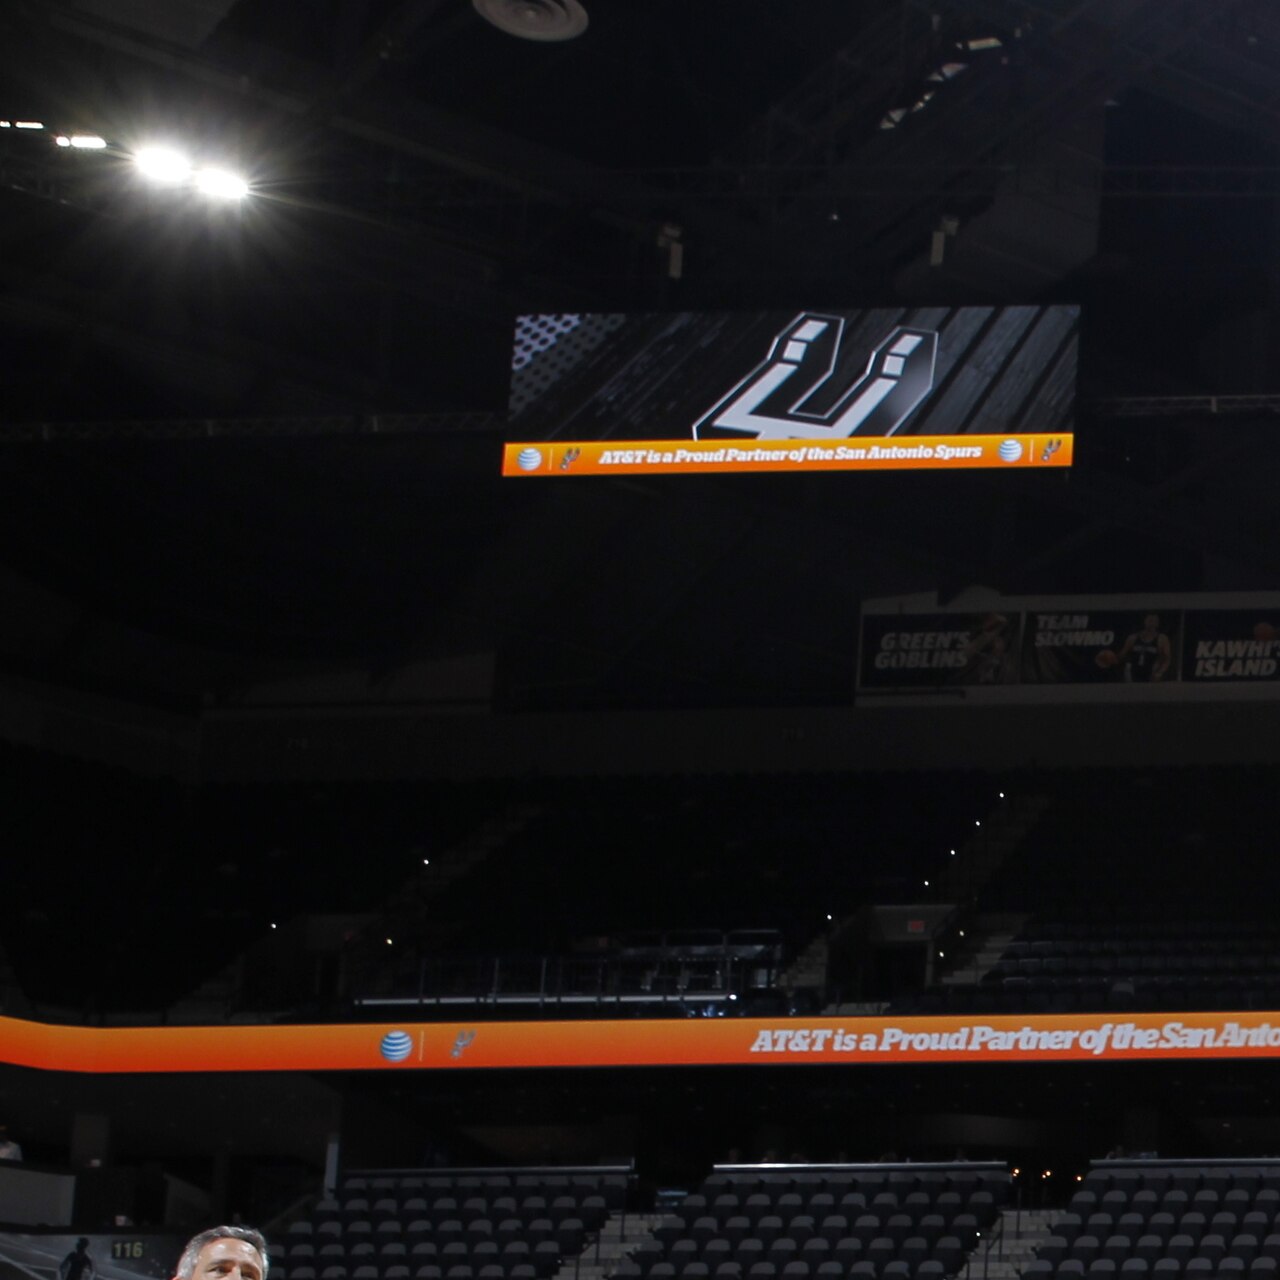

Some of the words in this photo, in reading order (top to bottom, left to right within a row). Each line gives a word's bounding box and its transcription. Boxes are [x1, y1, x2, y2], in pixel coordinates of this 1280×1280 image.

[599, 450, 646, 464] AT&T
[647, 449, 661, 463] is
[663, 453, 673, 463] a
[674, 449, 724, 463] Proud
[726, 448, 789, 462] Partner
[790, 447, 807, 463] of
[808, 447, 834, 461] the
[835, 446, 866, 460] San
[867, 445, 933, 459] Antonio
[935, 445, 982, 460] Spurs
[1037, 615, 1089, 629] TEAM
[1035, 630, 1114, 647] SLOWMO
[875, 651, 968, 669] GOBLINS
[1195, 659, 1277, 677] ISLAND
[751, 1030, 832, 1052] AT&T
[833, 1029, 857, 1050] is
[859, 1034, 877, 1050] a
[879, 1028, 968, 1050] Proud
[969, 1026, 1079, 1050] Partner
[1081, 1023, 1113, 1054] of
[1112, 1023, 1159, 1049] the
[1160, 1022, 1216, 1048] San
[114, 1242, 143, 1259] 116
